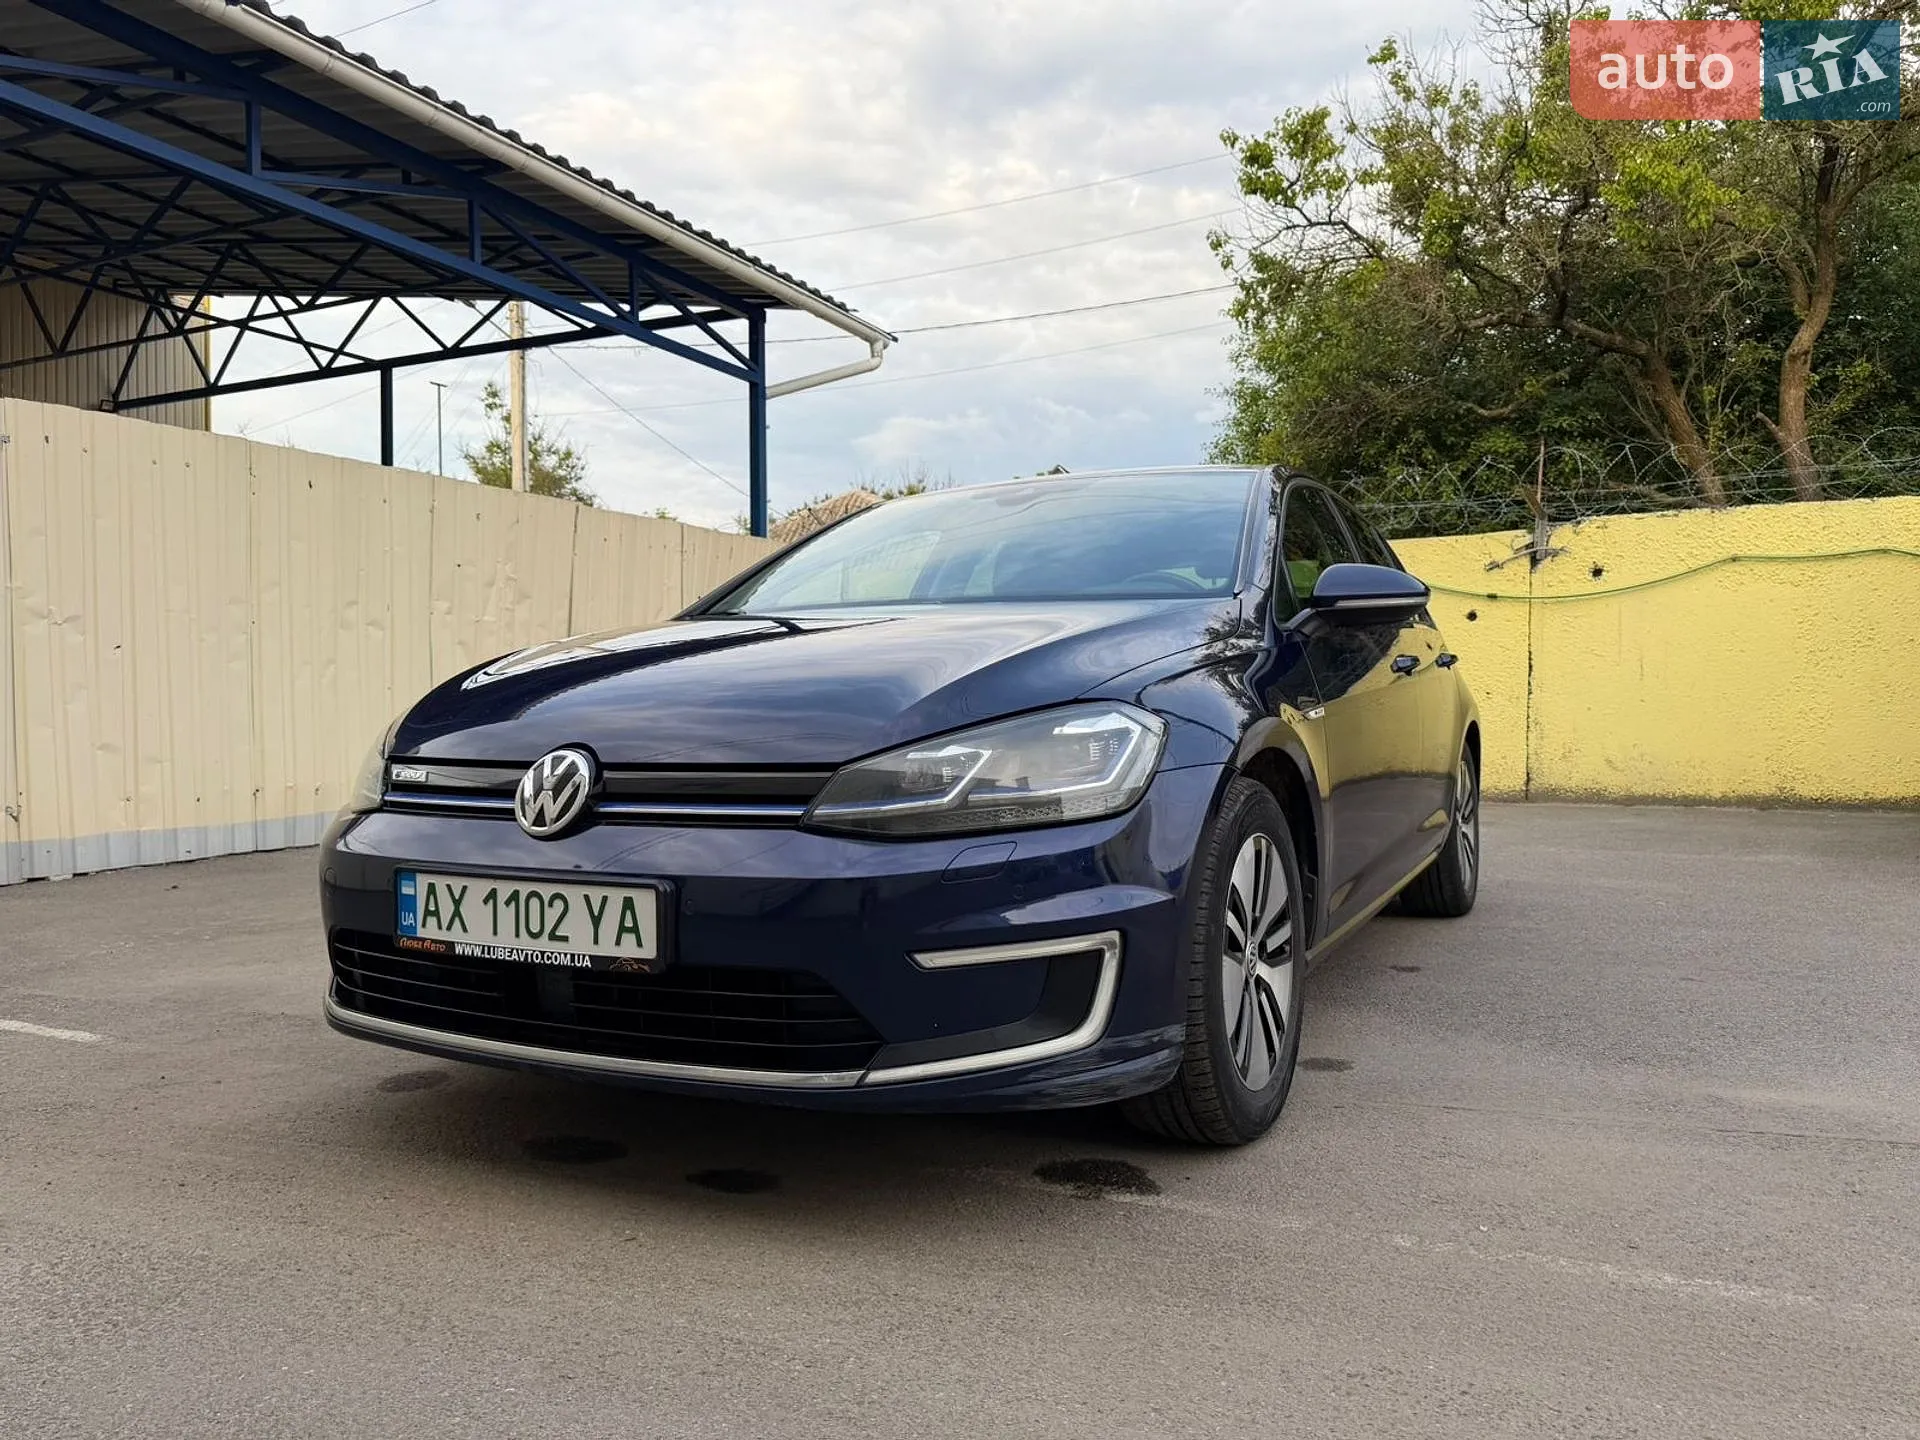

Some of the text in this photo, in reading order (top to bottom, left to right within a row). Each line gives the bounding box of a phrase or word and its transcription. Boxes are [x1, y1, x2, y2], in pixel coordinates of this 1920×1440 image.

[401, 911, 416, 926] UA
[421, 882, 643, 948] AX 1102 YA
[454, 942, 592, 969] WWW.LUBEAVTO.COM.UA
